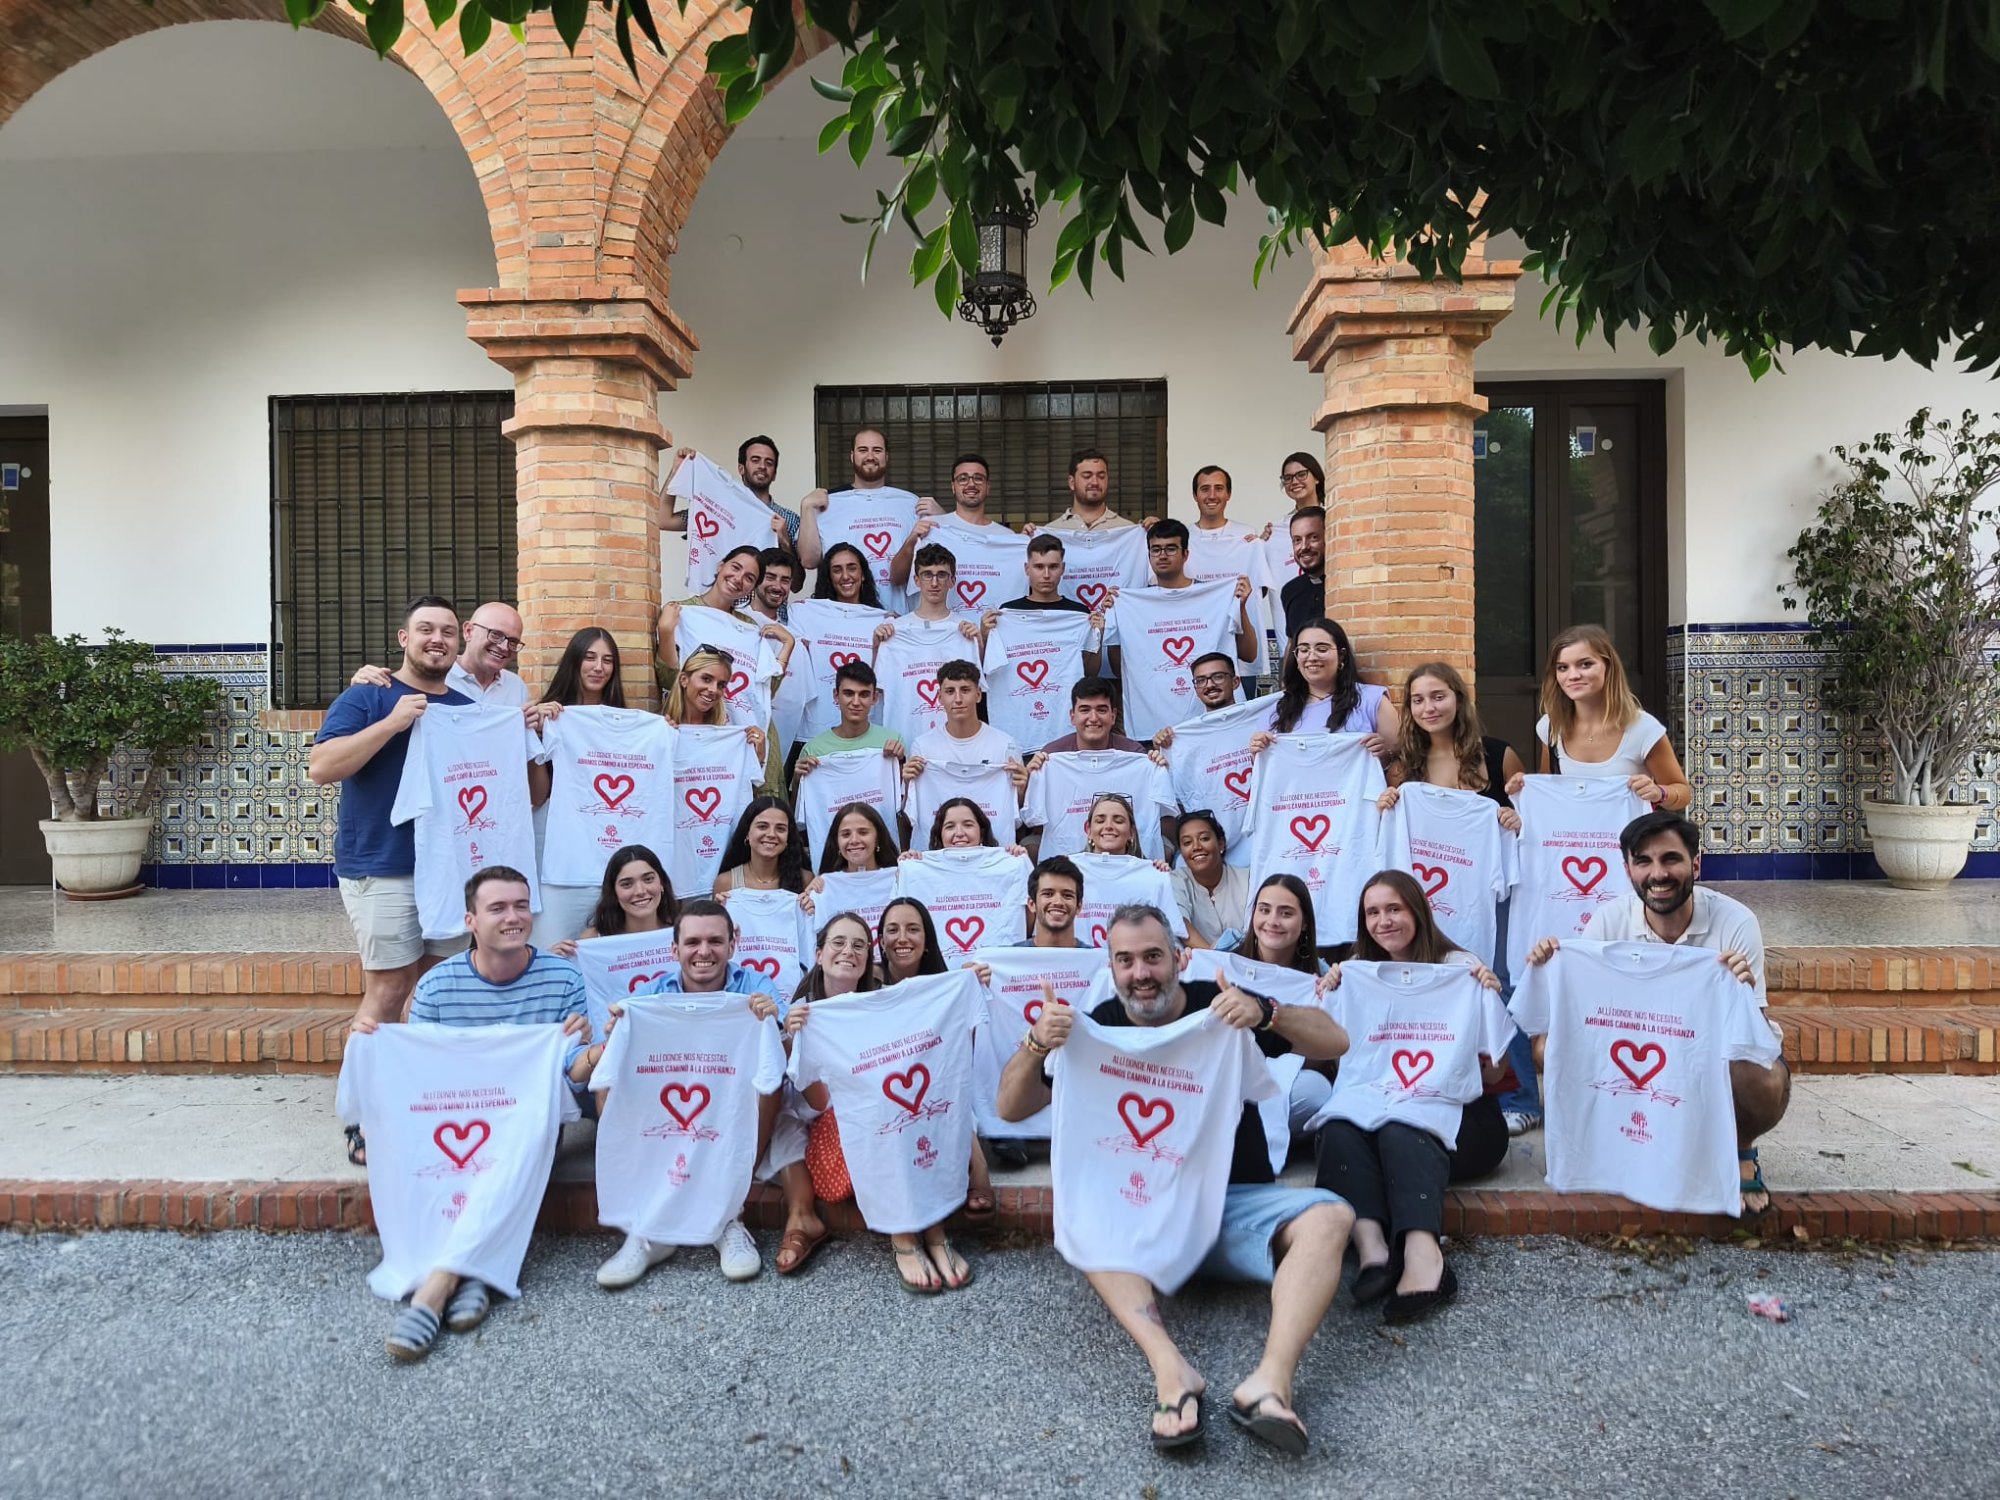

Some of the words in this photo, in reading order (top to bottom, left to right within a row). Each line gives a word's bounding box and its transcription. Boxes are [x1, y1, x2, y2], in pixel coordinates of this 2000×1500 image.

[1611, 1008, 1633, 1019] DONDE
[1634, 1011, 1648, 1020] NOS
[1648, 1012, 1683, 1025] NECESITAS
[1585, 1017, 1614, 1028] ABRIMOS
[1615, 1021, 1641, 1031] CAMINO
[1648, 1024, 1656, 1033] LA
[1657, 1026, 1695, 1039] ESPERANZA
[872, 1043, 892, 1058] DONDE
[892, 1039, 904, 1051] NOS
[904, 1028, 934, 1047] NECESITAS
[663, 1053, 683, 1062] DONDE
[684, 1053, 696, 1062] NOS
[697, 1053, 728, 1063] NECESITAS
[852, 1060, 878, 1075] ABRIMOS
[878, 1053, 902, 1068] CAMINO
[907, 1047, 915, 1057] LA
[915, 1036, 943, 1055] ESPERANZA
[637, 1065, 665, 1074] ABRIMOS
[665, 1064, 689, 1074] CAMINO
[695, 1065, 702, 1073] LA
[703, 1065, 736, 1075] ESPERANZA
[1100, 1064, 1126, 1080] ABRIMOS
[1127, 1071, 1151, 1084] CAMINO
[1158, 1078, 1166, 1088] LA
[1167, 1080, 1204, 1094] ESPERANZA
[1126, 1058, 1145, 1071] DONDE
[1147, 1063, 1159, 1074] NOS
[1160, 1065, 1194, 1080] NECESITAS
